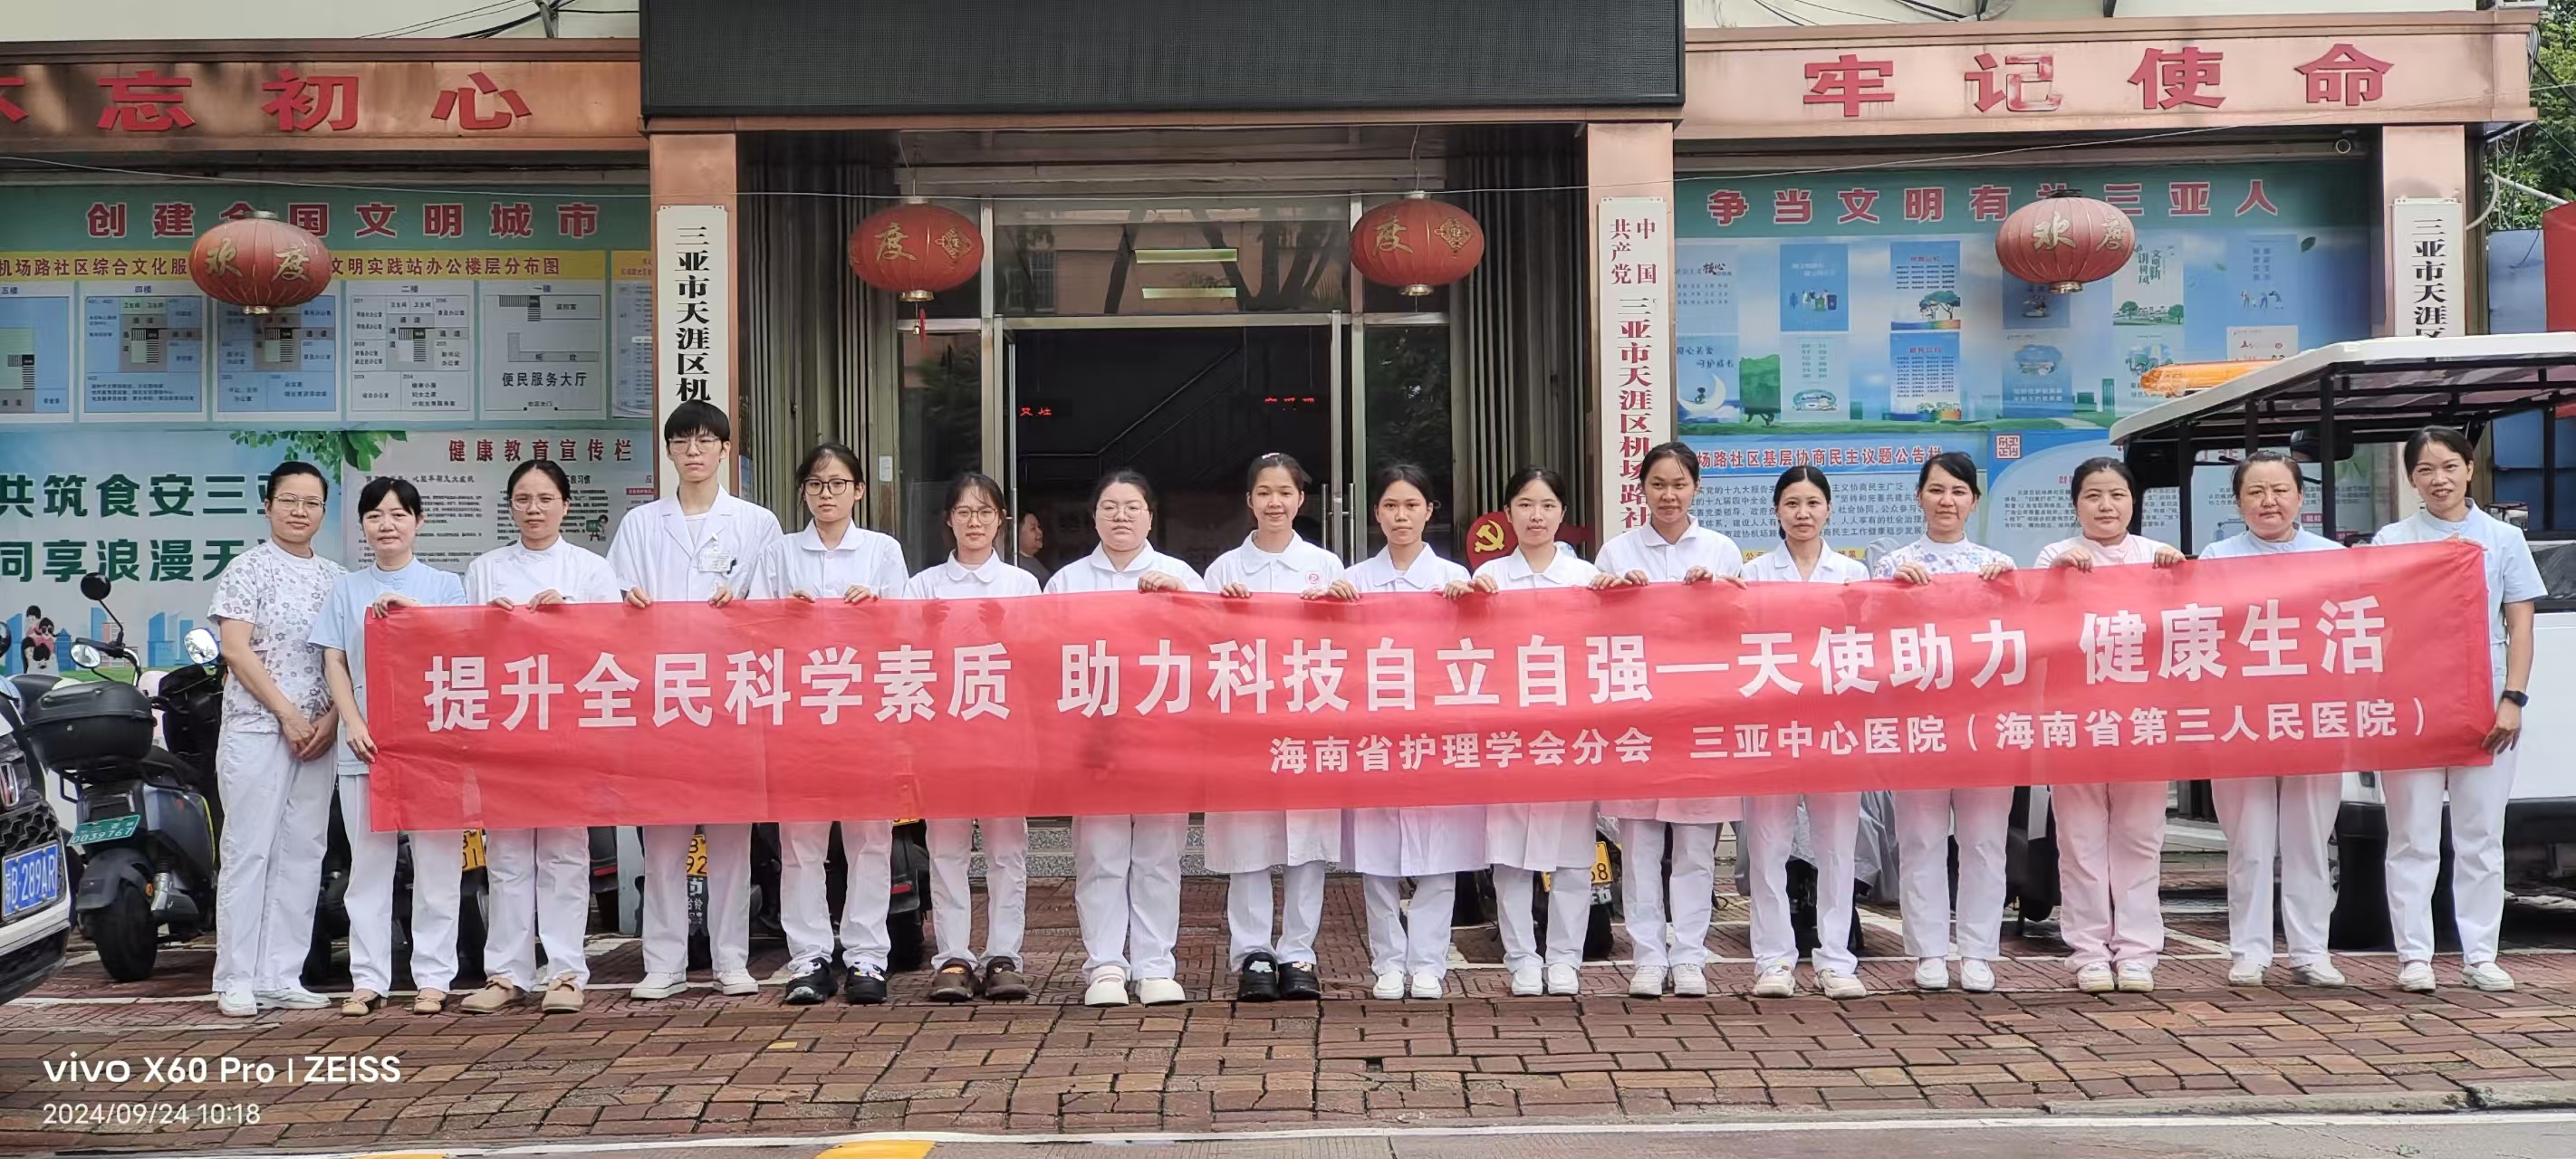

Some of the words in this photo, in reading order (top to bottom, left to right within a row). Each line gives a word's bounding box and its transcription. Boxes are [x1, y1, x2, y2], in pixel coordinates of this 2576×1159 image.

[1802, 43, 2394, 117] 牢记使命
[1706, 178, 2279, 226] 争当文明有三亚人
[331, 256, 560, 276] 文明实践站办公楼层分布图
[674, 225, 711, 402] 三亚市天涯区机
[502, 371, 588, 388] 便民服务大厅
[1617, 297, 1654, 536] 三亚市天涯区机场路社
[448, 438, 632, 463] 健康教育宣传栏
[1717, 529, 1779, 539] 市政协机场路
[0, 539, 265, 582] 同享浪漫天
[423, 641, 1012, 733] 提升全民科学素质
[2079, 594, 2388, 684] 健康生活
[1270, 725, 1654, 774] 海南省护理学会分会
